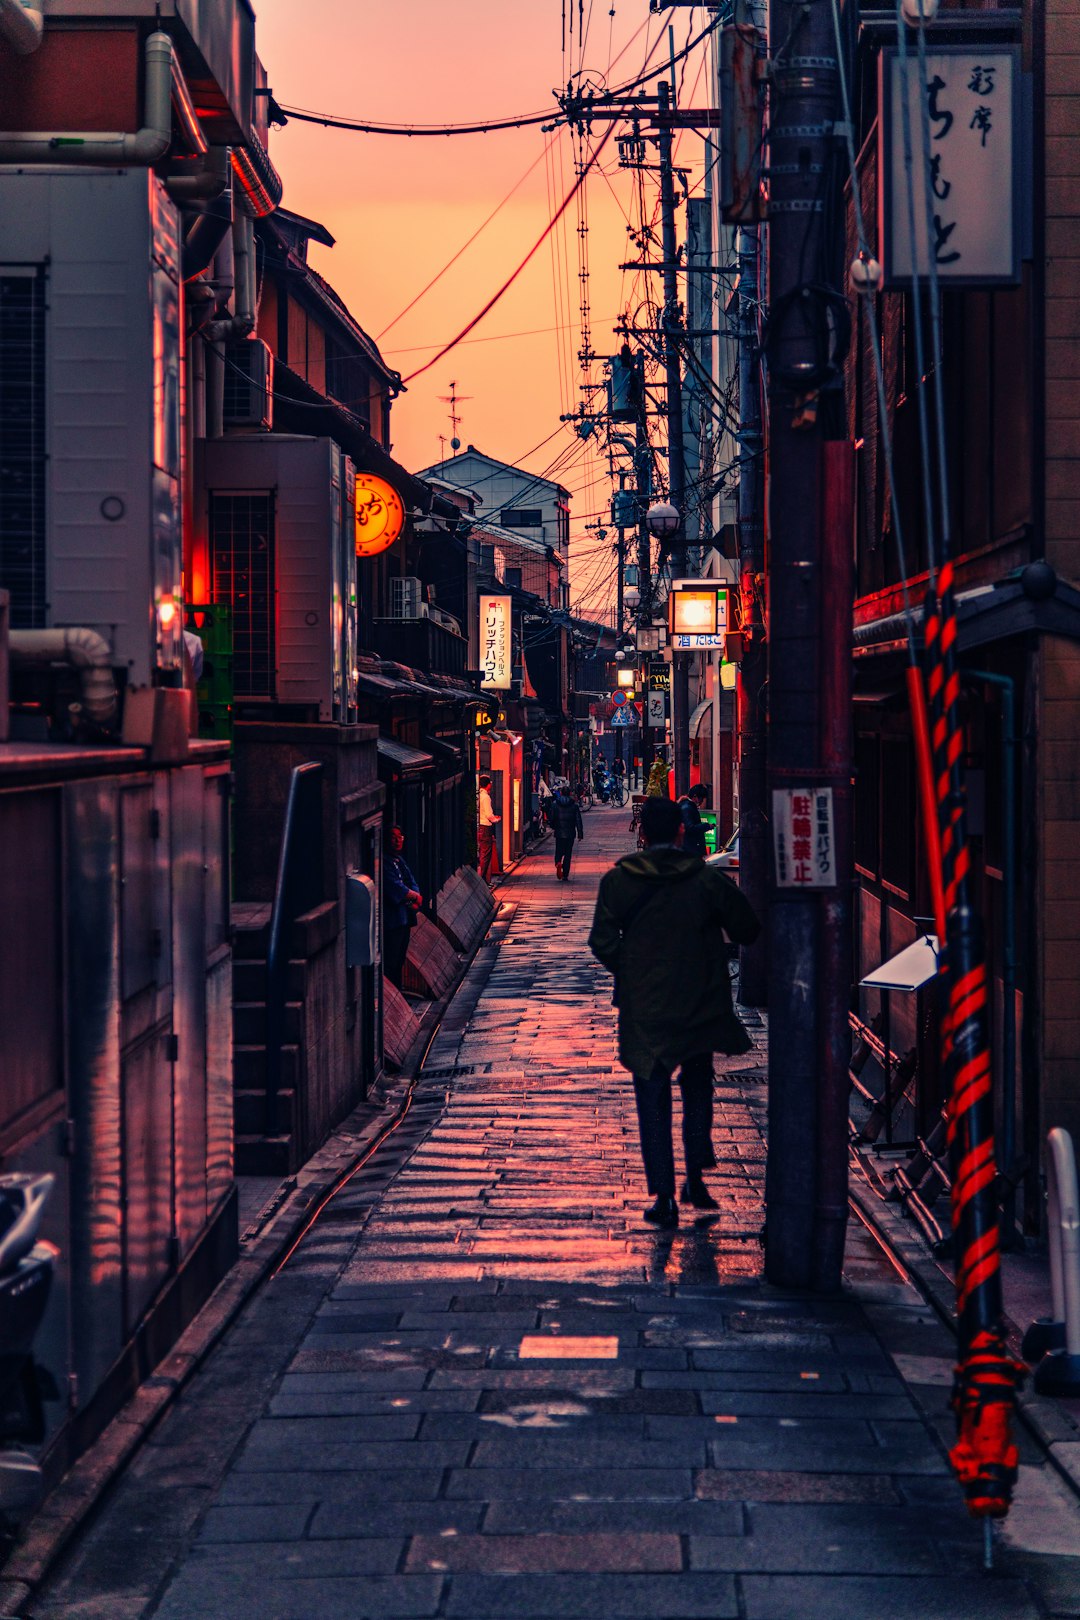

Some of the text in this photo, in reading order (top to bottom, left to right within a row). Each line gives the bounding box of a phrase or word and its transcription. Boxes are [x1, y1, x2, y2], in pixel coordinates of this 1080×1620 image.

[927, 75, 961, 263] ちもと
[485, 617, 496, 682] リッチハウス
[678, 634, 722, 647] 酒 たばこ
[792, 796, 812, 882] 駐輪禁止
[816, 796, 830, 874] 自転車バイク
